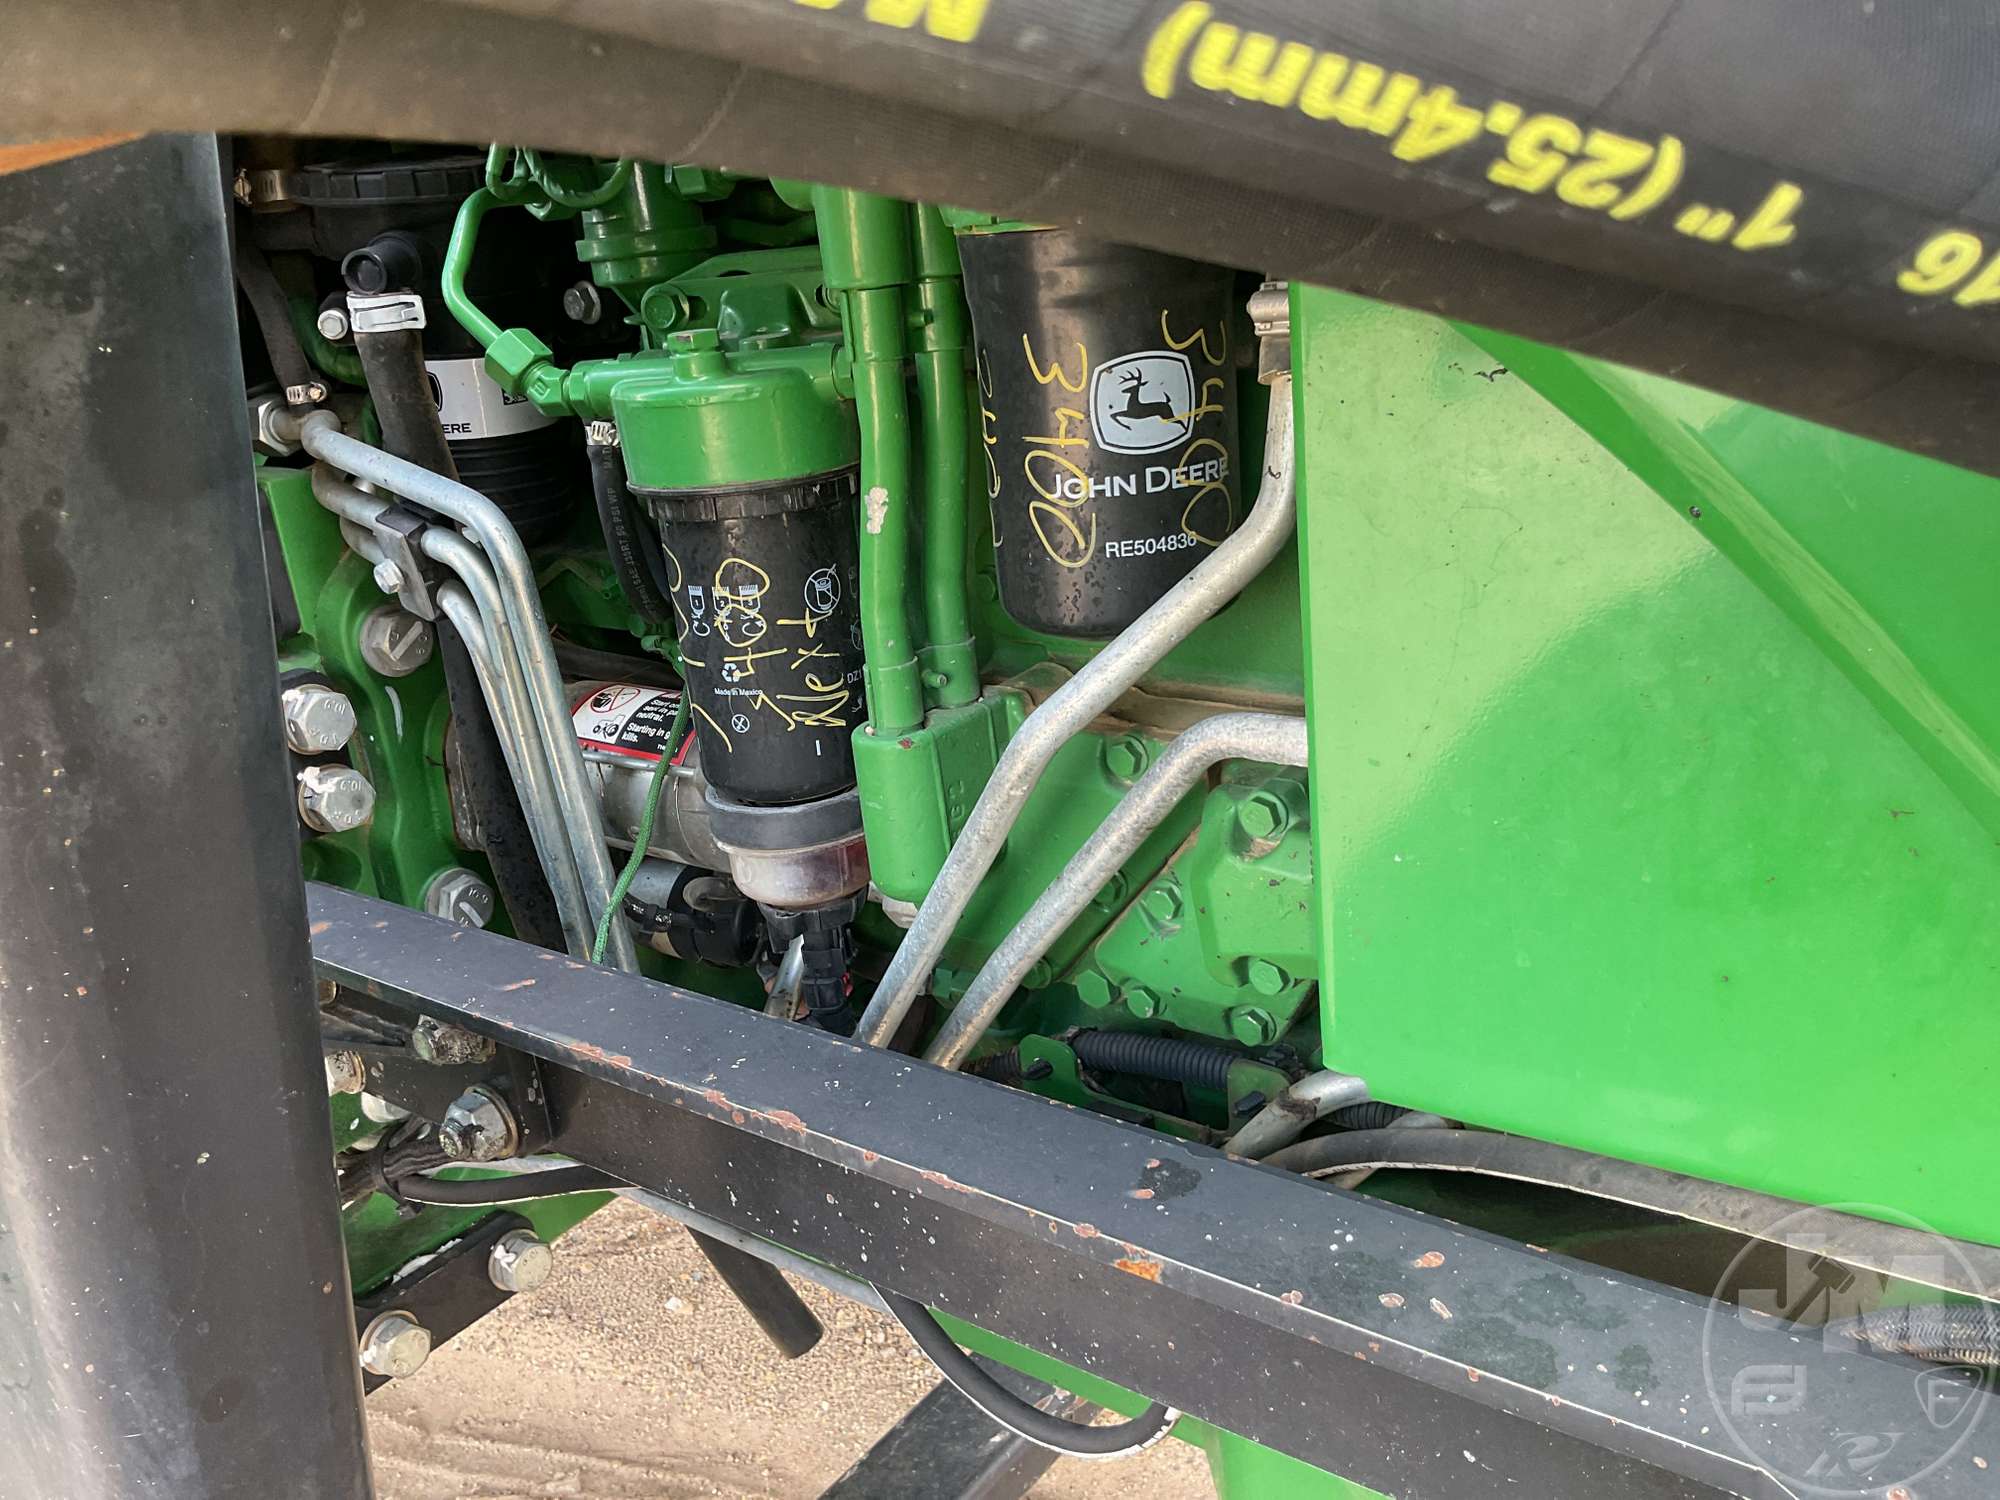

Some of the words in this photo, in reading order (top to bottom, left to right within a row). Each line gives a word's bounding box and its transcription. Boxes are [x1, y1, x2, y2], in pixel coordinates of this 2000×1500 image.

[1141, 0, 1685, 221] (25.4mm)
[1022, 333, 1097, 568] 3400
[1050, 473, 1136, 500] JOHN
[1146, 458, 1229, 493] DEERE
[1105, 531, 1197, 558] RE504836
[776, 607, 850, 727] Next
[739, 688, 763, 697] Mexico
[627, 722, 656, 737] Starting
[656, 728, 665, 737] in
[636, 712, 663, 722] neutral.
[621, 731, 639, 743] kills.
